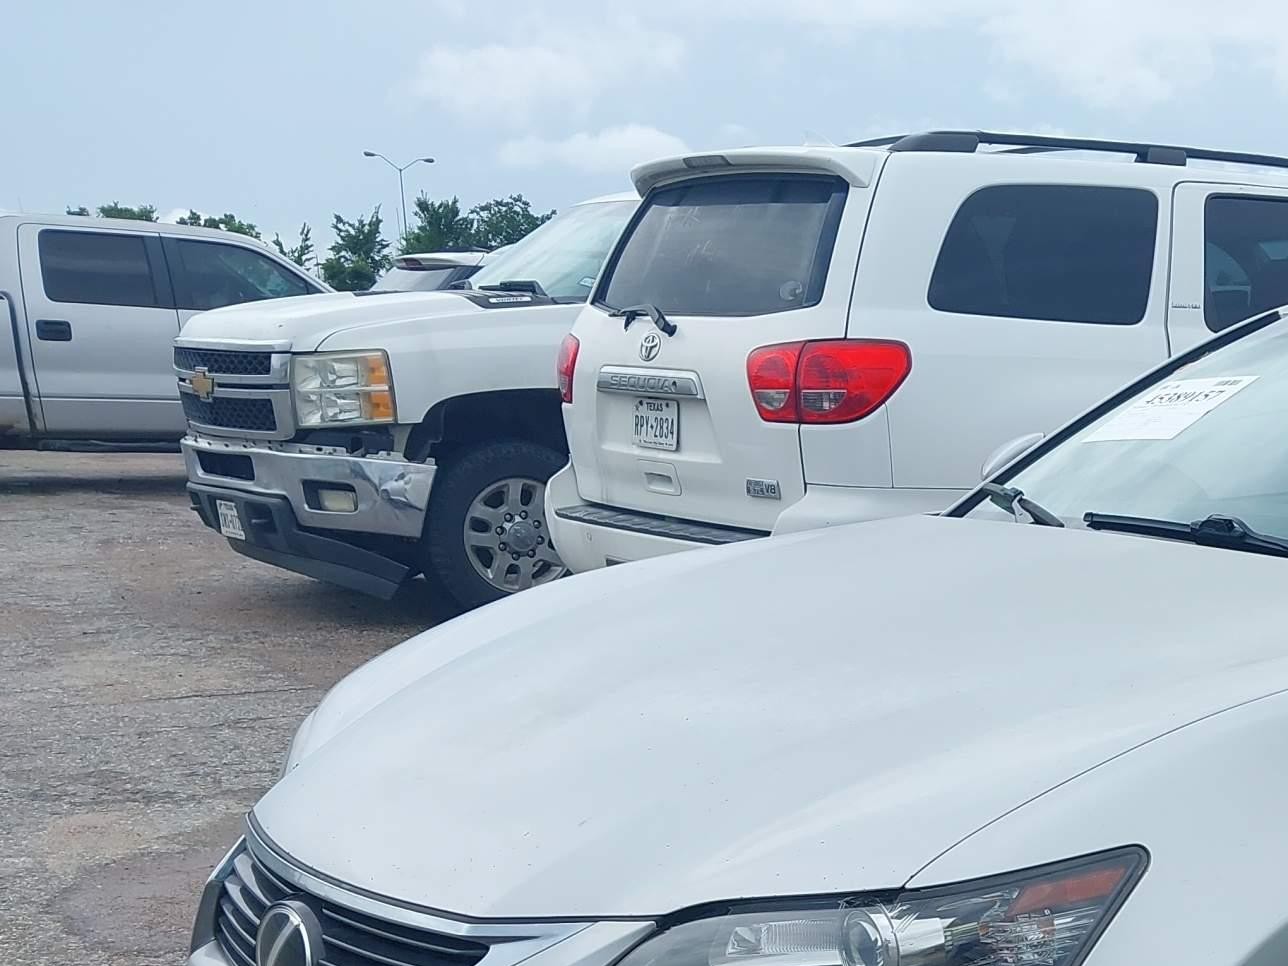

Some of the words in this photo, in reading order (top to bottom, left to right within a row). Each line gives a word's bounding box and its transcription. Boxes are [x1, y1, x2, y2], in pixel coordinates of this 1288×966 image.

[610, 375, 671, 393] SEQUOIA
[646, 402, 664, 412] TEXAS
[764, 483, 777, 495] V8
